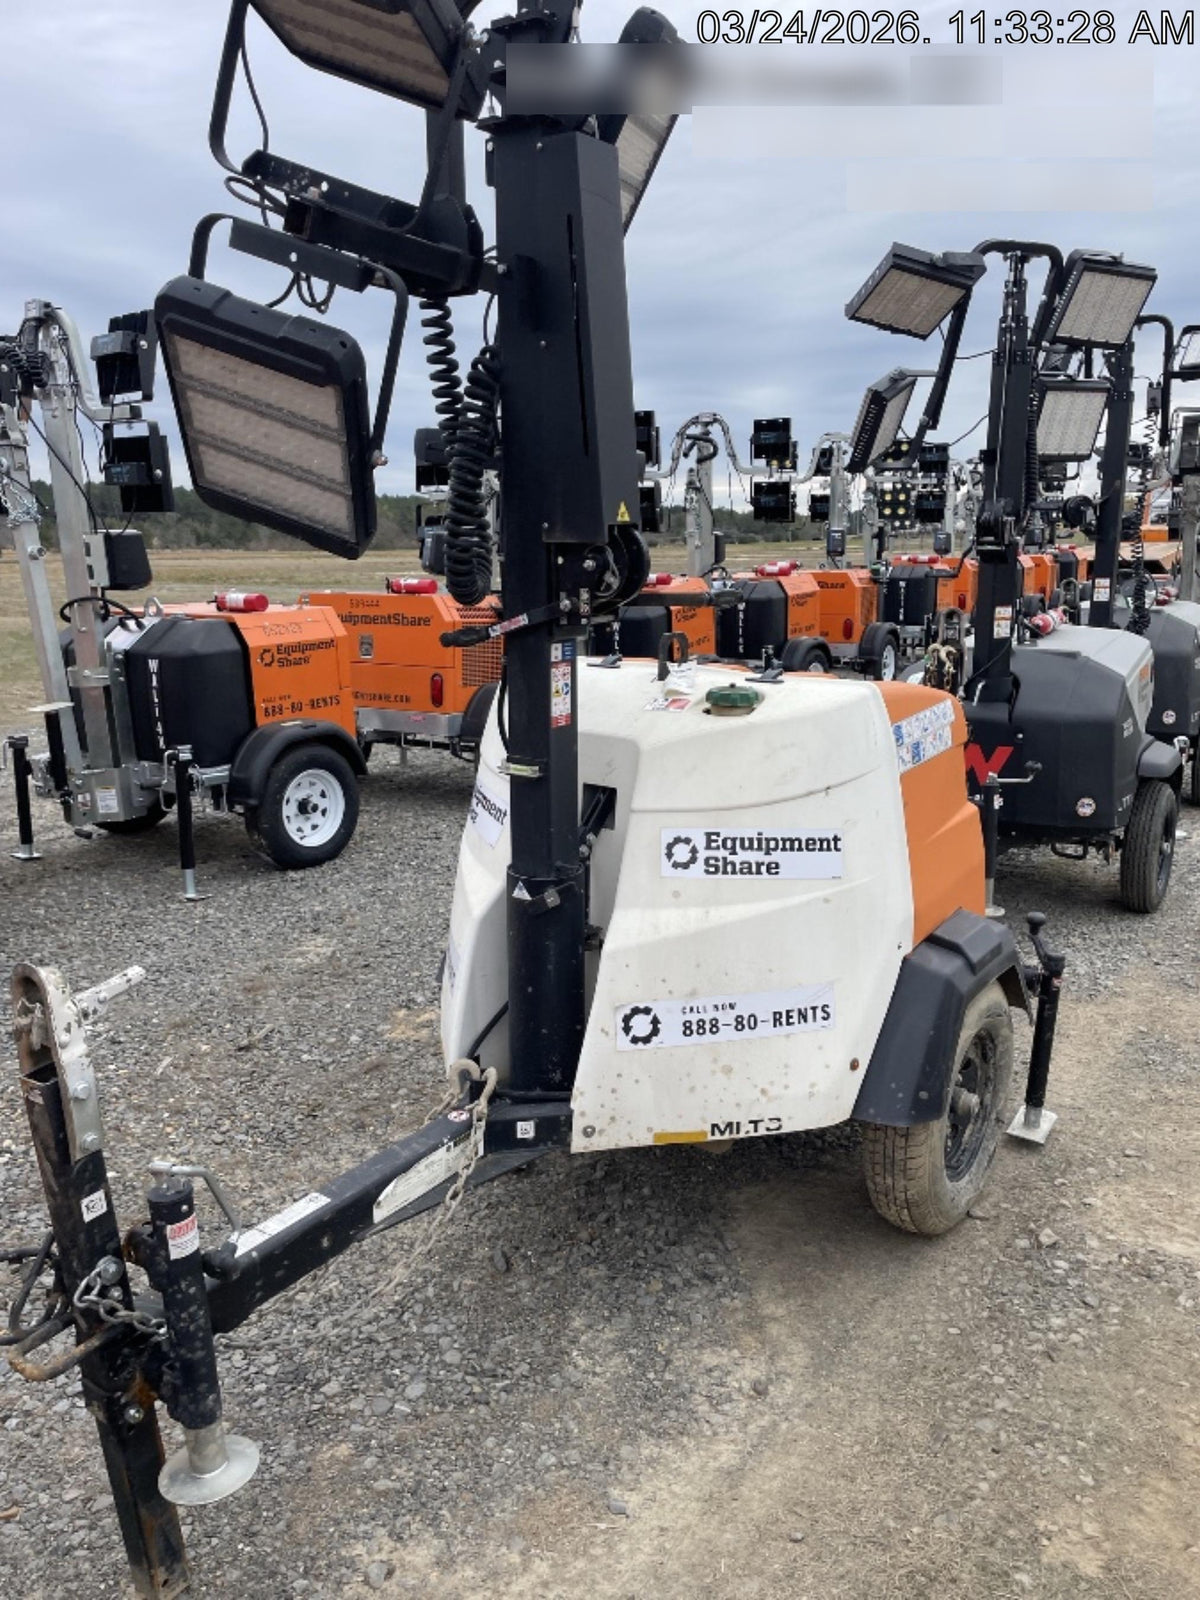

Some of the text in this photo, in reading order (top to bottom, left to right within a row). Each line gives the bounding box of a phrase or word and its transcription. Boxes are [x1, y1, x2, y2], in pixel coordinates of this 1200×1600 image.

[337, 611, 432, 627] uipmentShare
[276, 639, 336, 656] Equipment
[276, 655, 311, 668] Share
[703, 831, 842, 856] Equipment
[703, 856, 781, 876] Share
[680, 1002, 737, 1016] CALL NOW
[682, 1003, 832, 1038] 888-80-RENTS
